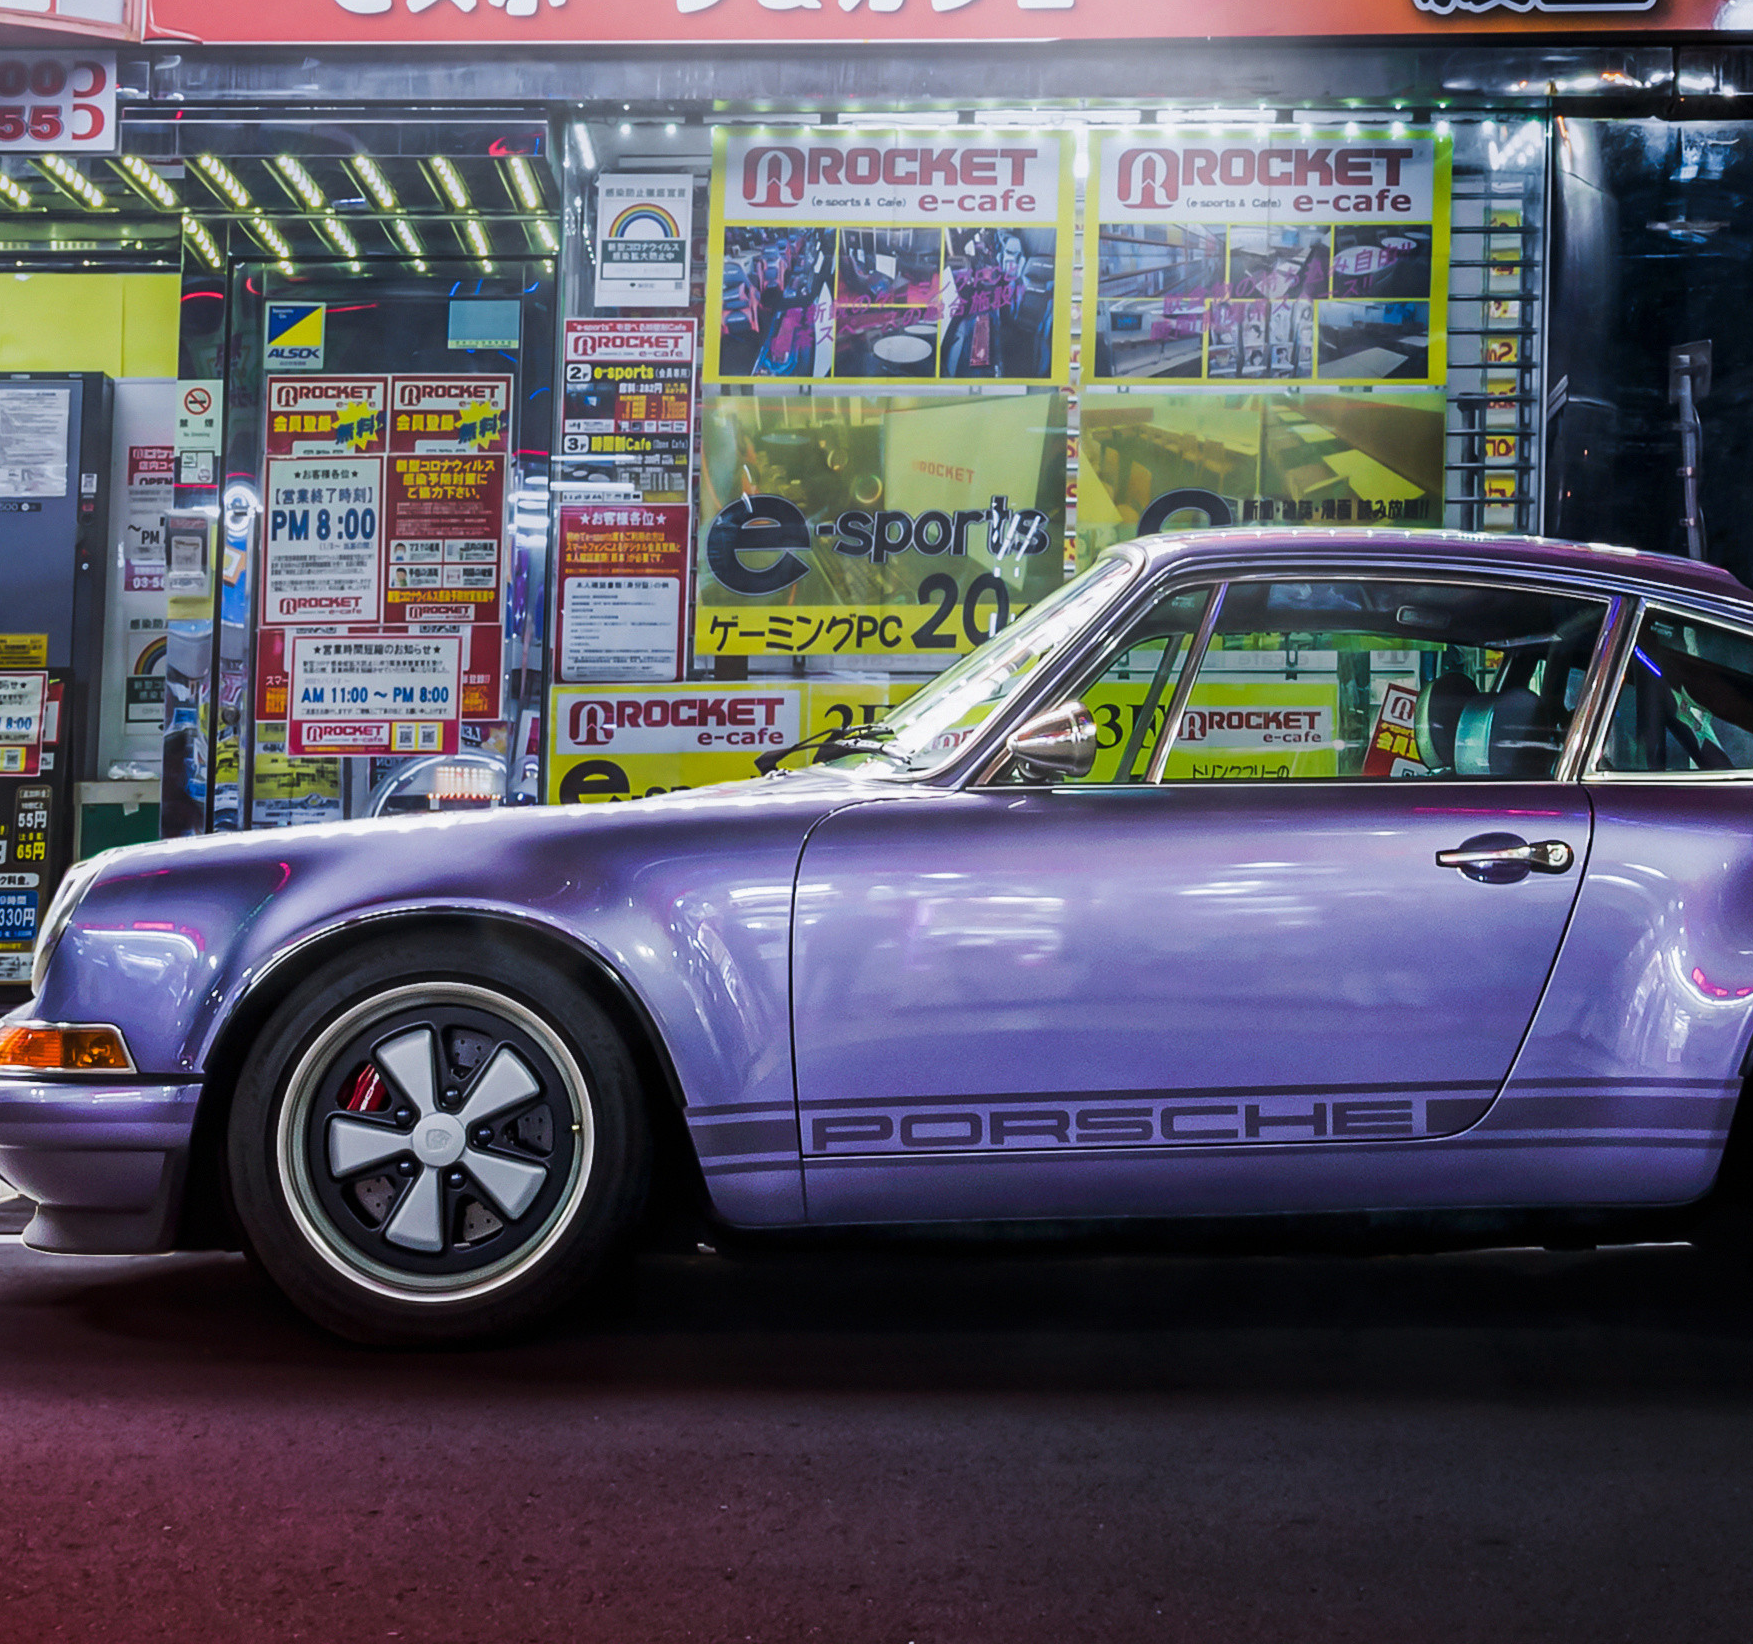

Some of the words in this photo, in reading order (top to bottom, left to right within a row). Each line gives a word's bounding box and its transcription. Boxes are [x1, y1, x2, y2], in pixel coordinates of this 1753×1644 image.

[807, 148, 1038, 185] ROCKET
[1181, 148, 1413, 186] ROCKET
[918, 189, 1036, 212] e-cafe
[1293, 189, 1412, 213] e-cafe
[597, 336, 684, 348] ROCKET
[268, 347, 320, 359] ALSOK
[593, 364, 654, 381] e-sports
[299, 386, 376, 399] ROCKET
[422, 385, 499, 398] ROCKET
[273, 415, 332, 432] 会員登録
[396, 414, 455, 431] 会員登録
[271, 509, 310, 542] PM
[706, 493, 1050, 597] e-sports
[296, 597, 363, 608] ROCKET
[422, 605, 471, 615] ROCKET
[710, 614, 903, 652] ゲーミングPC
[301, 687, 324, 703] AM
[331, 687, 369, 703] 11:00
[393, 687, 414, 703] PM
[419, 687, 449, 703] 8:00
[617, 697, 784, 728] ROCKET
[1204, 711, 1322, 730] ROCKET
[6, 716, 32, 730] 8:00
[322, 725, 384, 737] ROCKET
[697, 728, 784, 746] e-cafe
[1262, 730, 1322, 744] e-cafe
[18, 811, 47, 829] 55円
[16, 842, 46, 861] 65円
[812, 1100, 1413, 1151] PORSCHE
